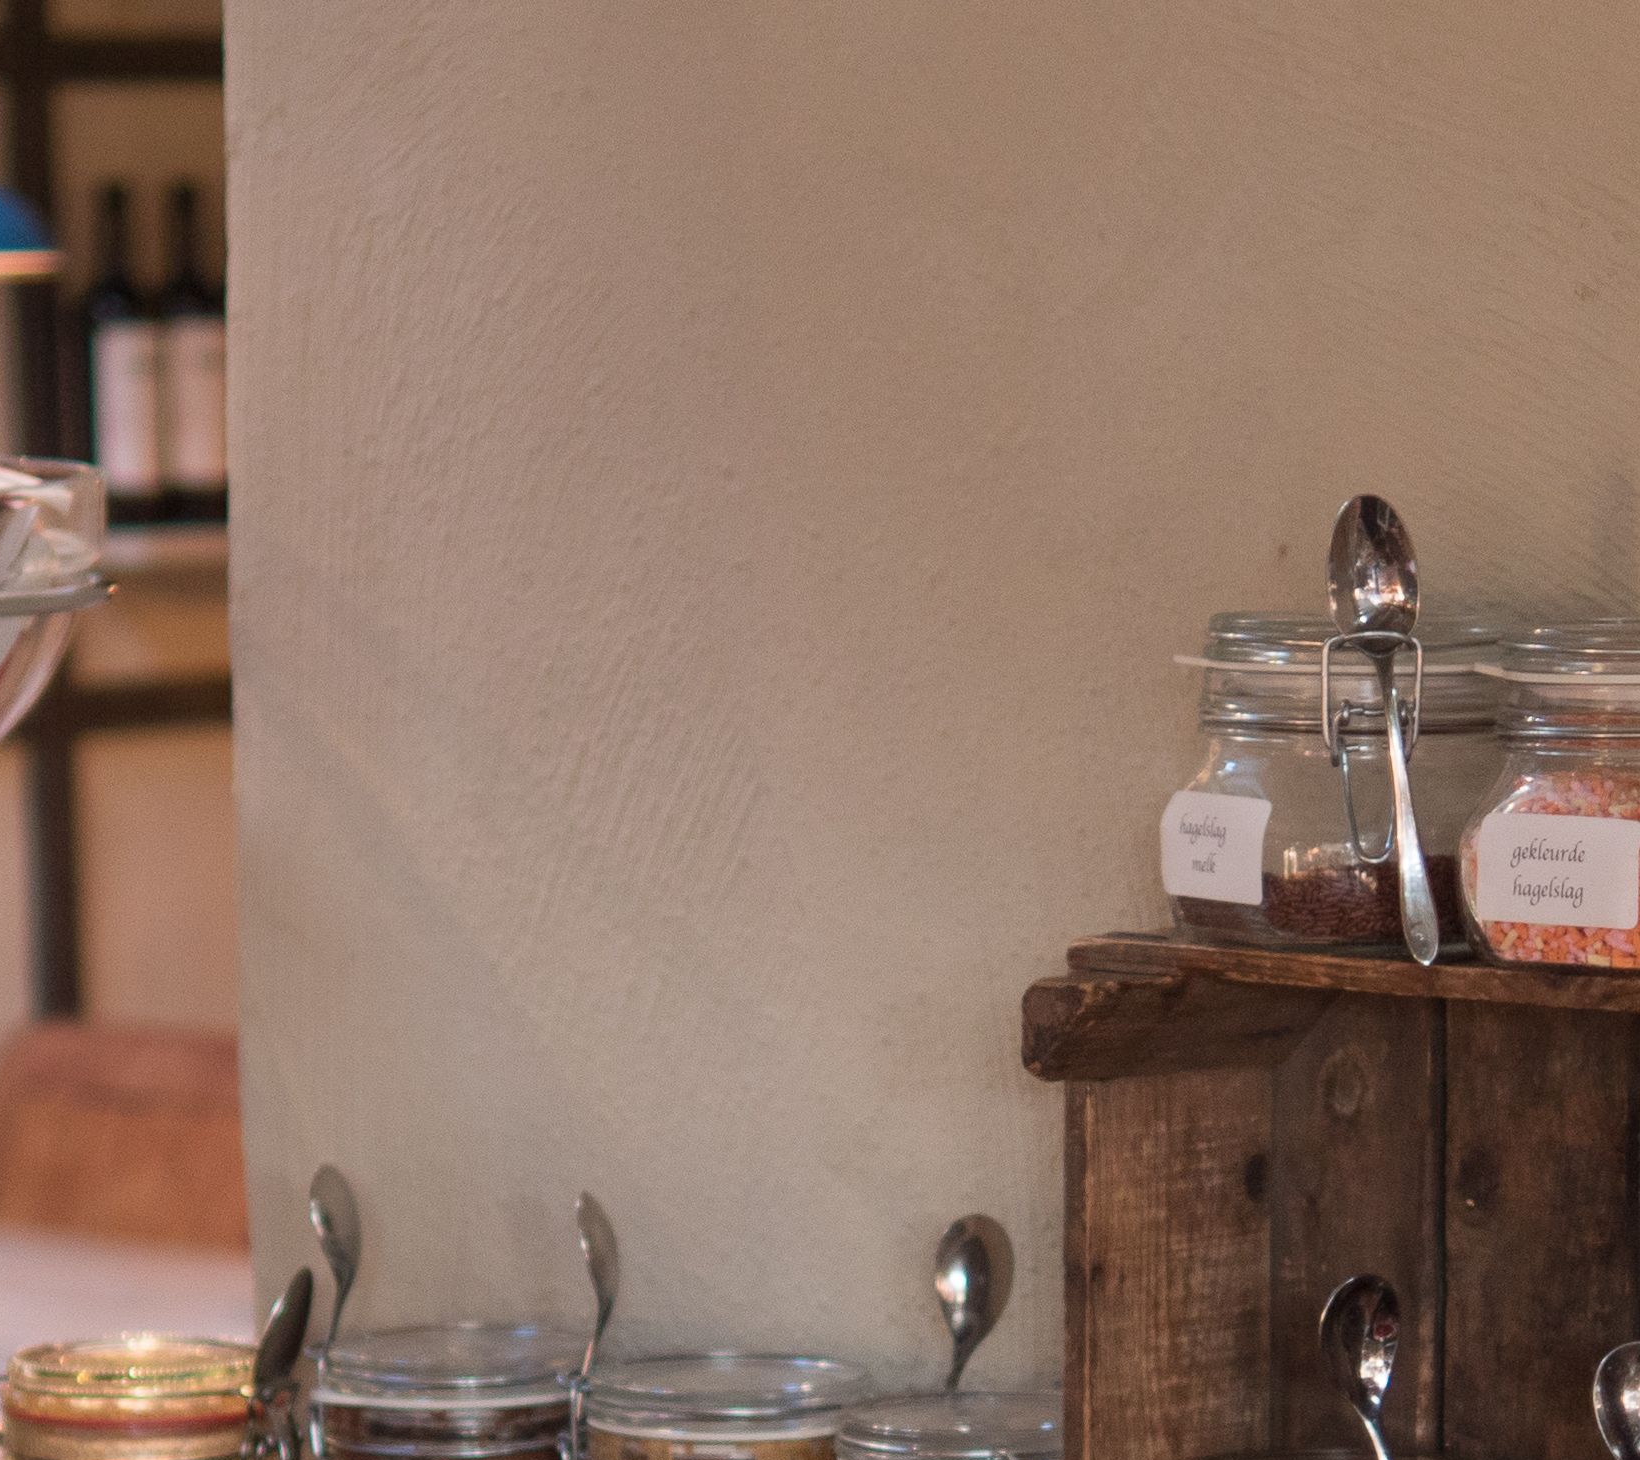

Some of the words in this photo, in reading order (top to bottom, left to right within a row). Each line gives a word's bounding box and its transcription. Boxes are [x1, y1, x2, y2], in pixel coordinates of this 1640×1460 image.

[1179, 813, 1227, 848] hagelslag
[1192, 852, 1217, 873] melk
[1510, 837, 1586, 868] gekleurde
[1512, 874, 1584, 909] hagelslag
